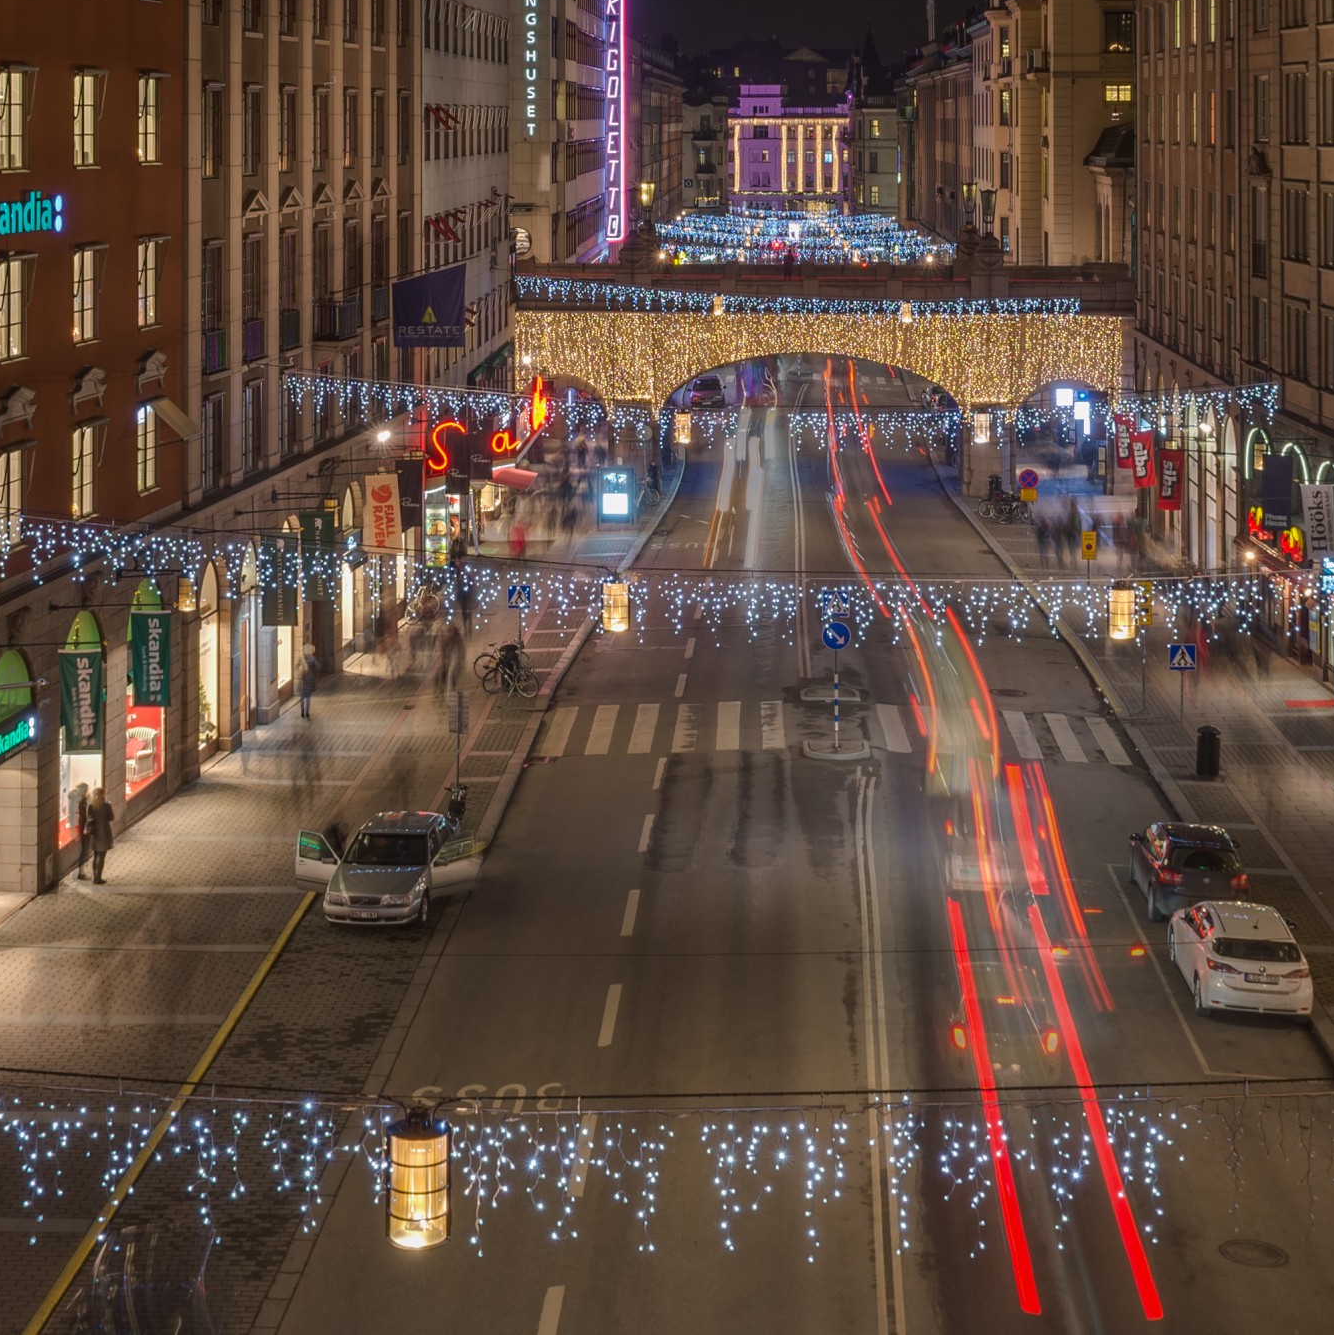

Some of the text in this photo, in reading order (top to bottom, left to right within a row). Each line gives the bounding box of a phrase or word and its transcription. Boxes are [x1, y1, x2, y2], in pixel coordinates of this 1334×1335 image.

[398, 326, 461, 335] RESTATE
[1117, 424, 1130, 458] siba
[1132, 442, 1149, 477] siba
[1162, 460, 1178, 497] siba
[1308, 490, 1328, 552] Hööks
[411, 1082, 566, 1116] BUSS
